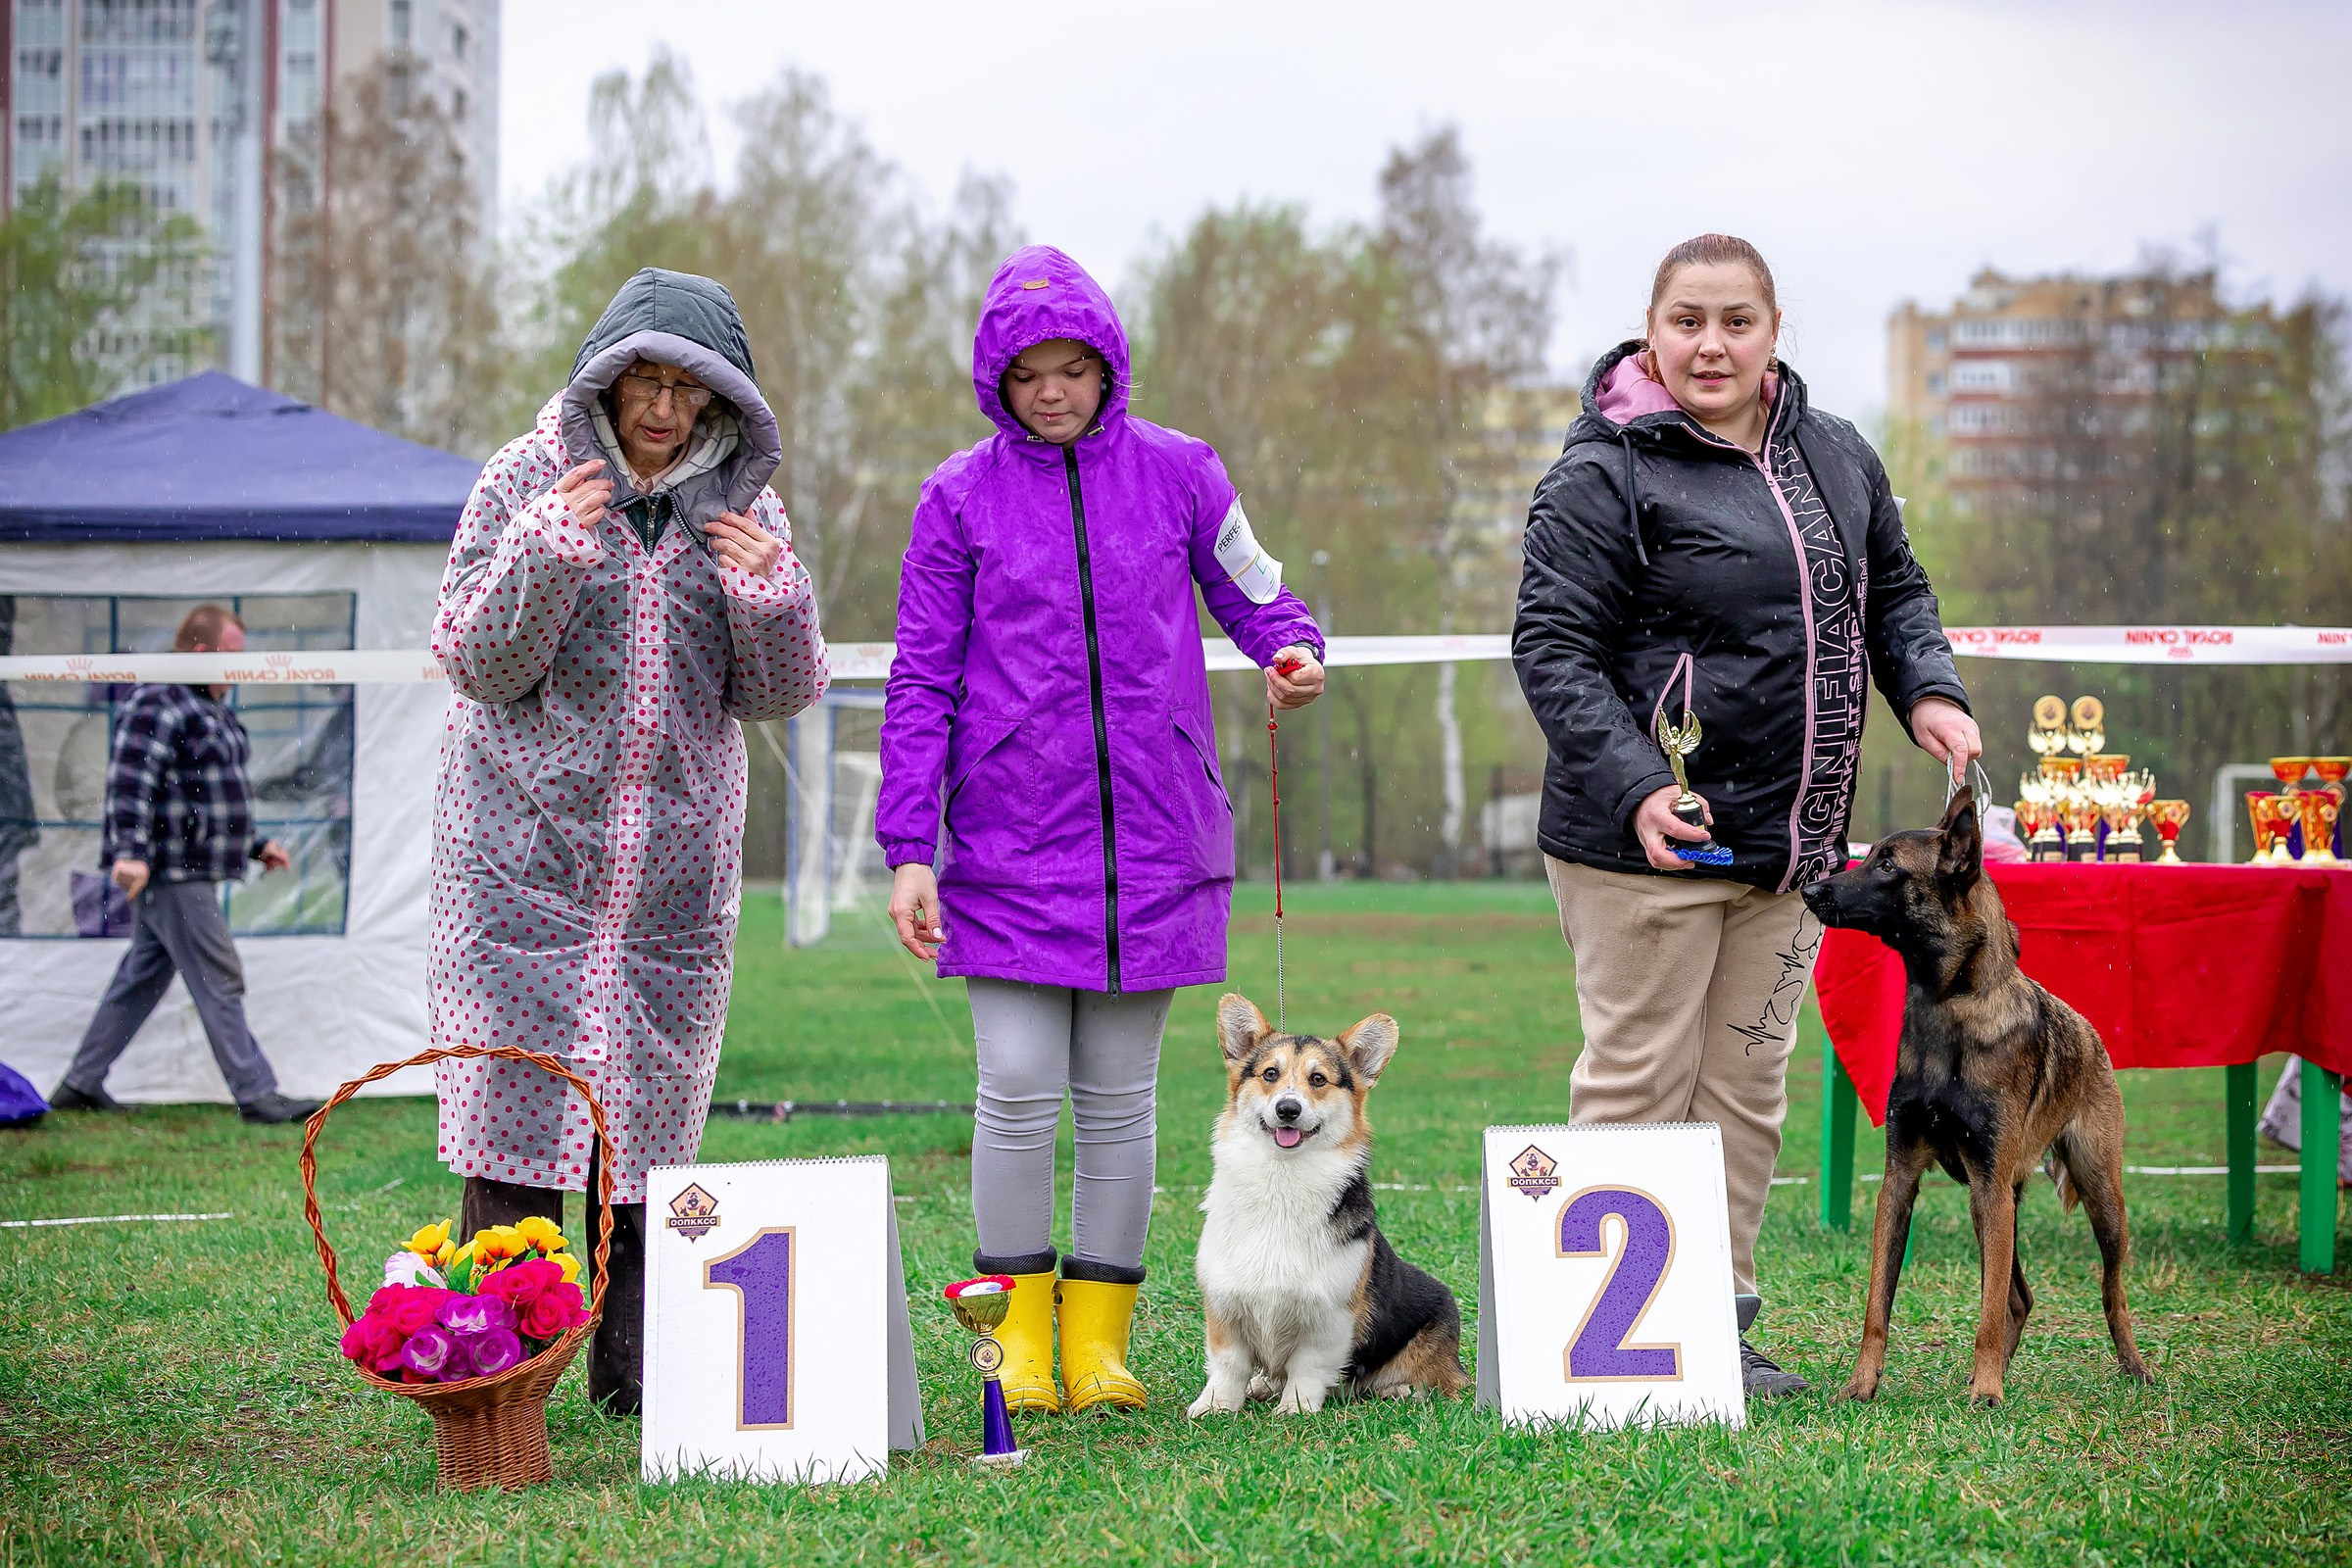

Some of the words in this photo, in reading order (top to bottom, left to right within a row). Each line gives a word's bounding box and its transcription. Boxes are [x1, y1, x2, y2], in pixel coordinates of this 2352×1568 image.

[1991, 629, 2041, 644] ROYAL
[2125, 630, 2180, 644] CANIN
[2183, 630, 2233, 644] ROYAL
[1835, 739, 1855, 818] MAKE
[1848, 703, 1860, 728] IT
[670, 1217, 716, 1226] ООПККСС
[1554, 1184, 1684, 1383] 2
[703, 1226, 796, 1431] 1
